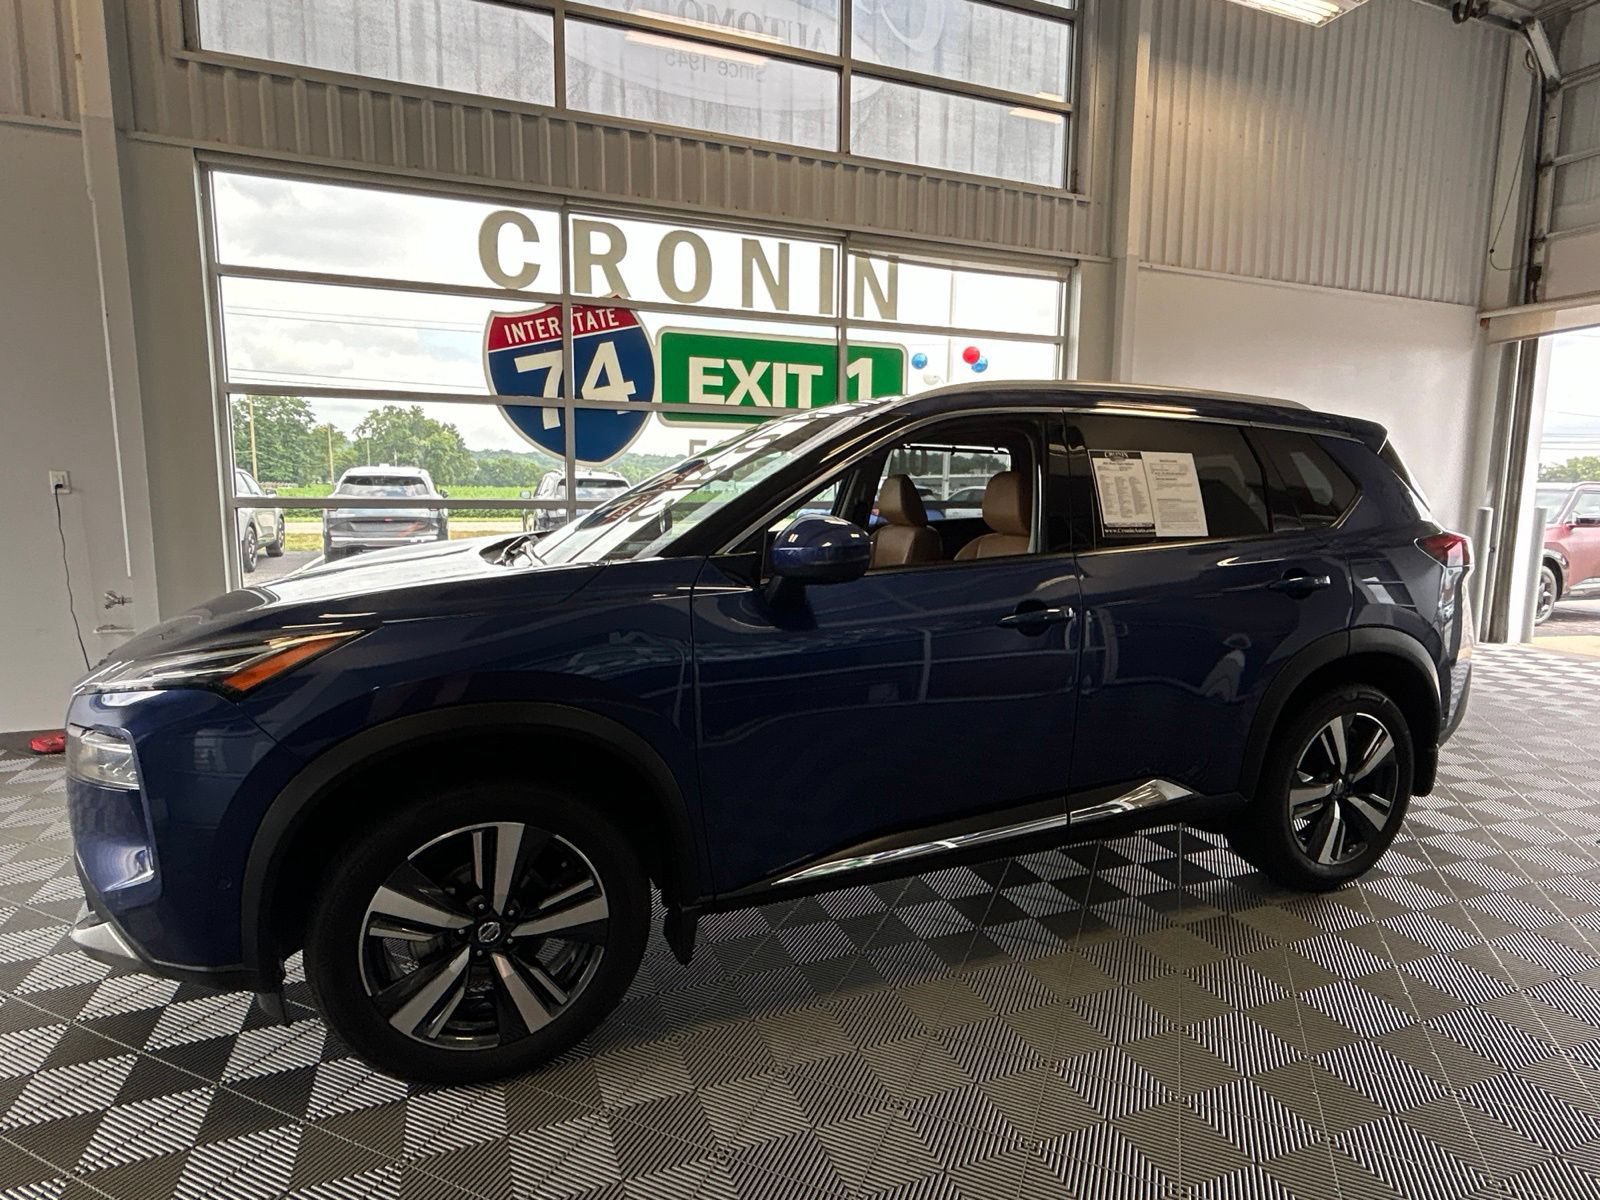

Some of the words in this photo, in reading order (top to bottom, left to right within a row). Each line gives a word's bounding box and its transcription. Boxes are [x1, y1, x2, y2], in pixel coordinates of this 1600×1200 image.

[478, 209, 899, 321] CRONIN
[504, 308, 620, 344] INTERTATE
[513, 340, 637, 430] 74
[688, 356, 824, 409] EXIT
[846, 357, 873, 401] 1
